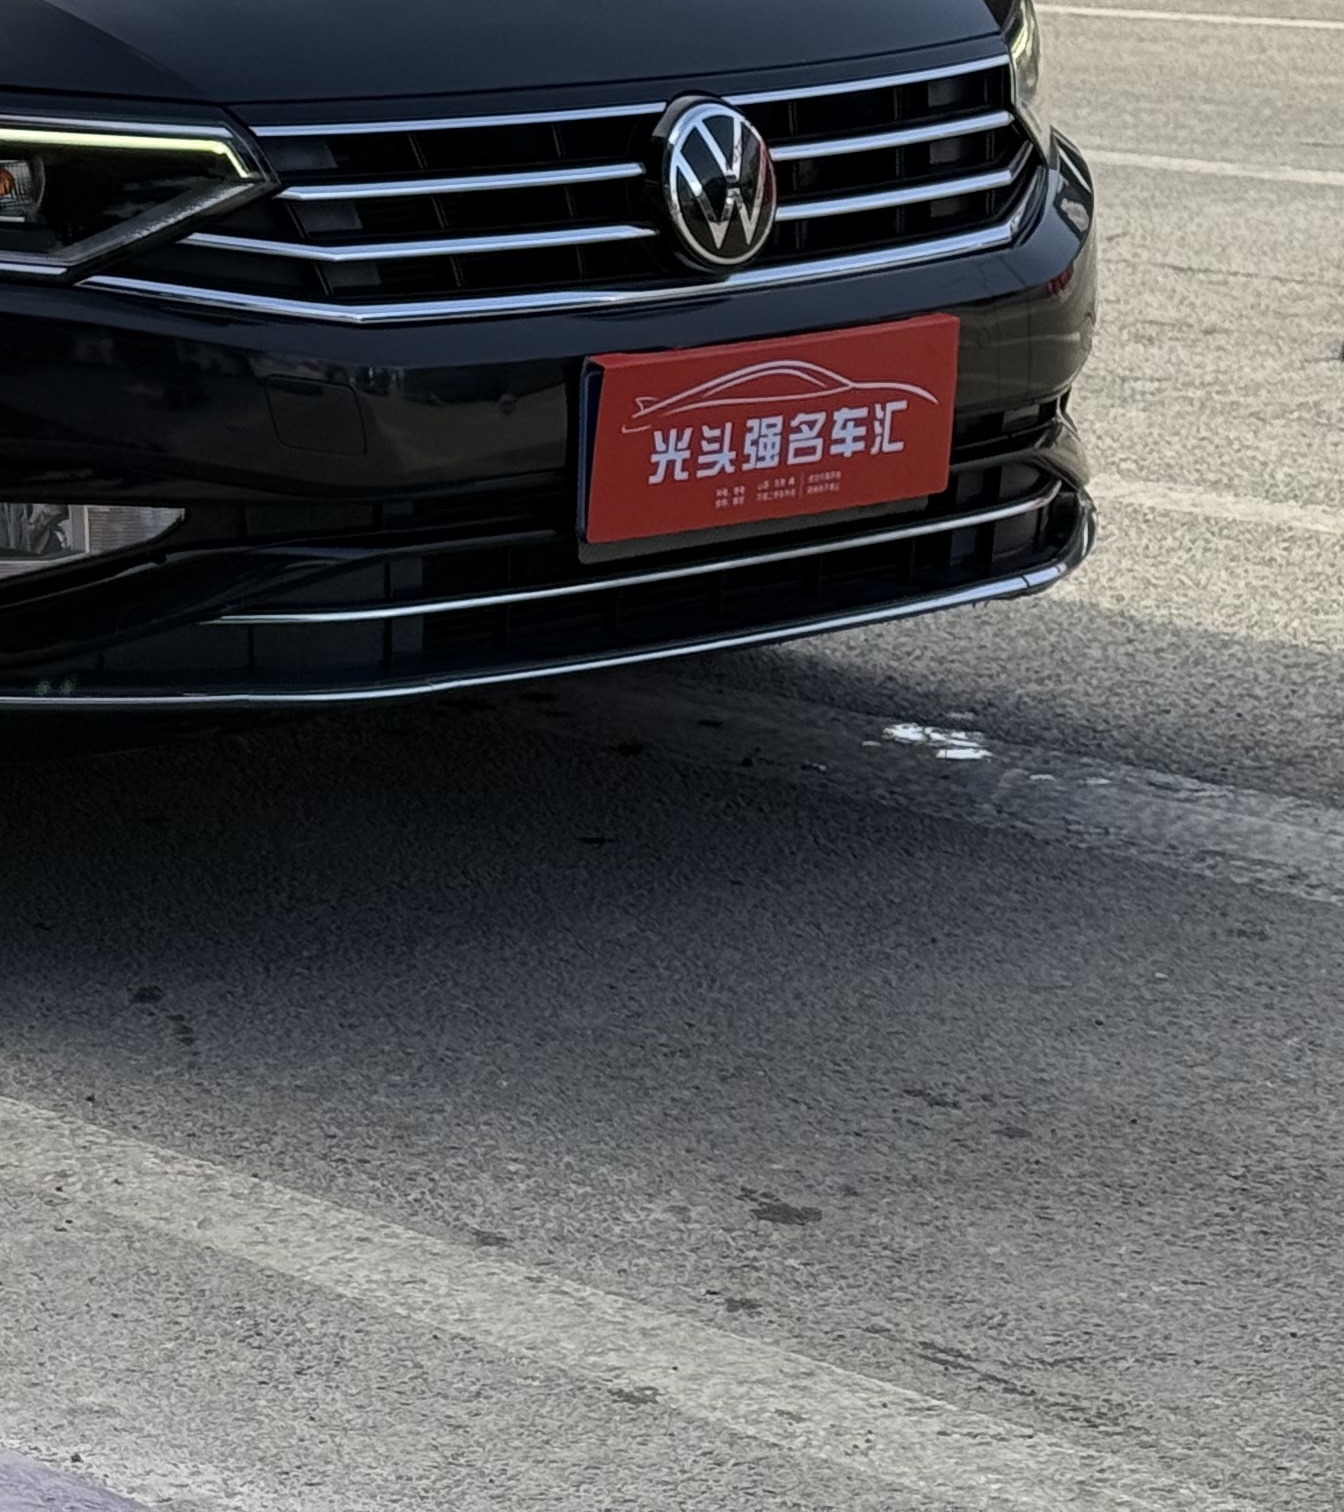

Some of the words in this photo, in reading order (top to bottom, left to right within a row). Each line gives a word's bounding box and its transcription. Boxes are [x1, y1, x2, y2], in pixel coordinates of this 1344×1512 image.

[648, 399, 907, 485] 光头强名车汇
